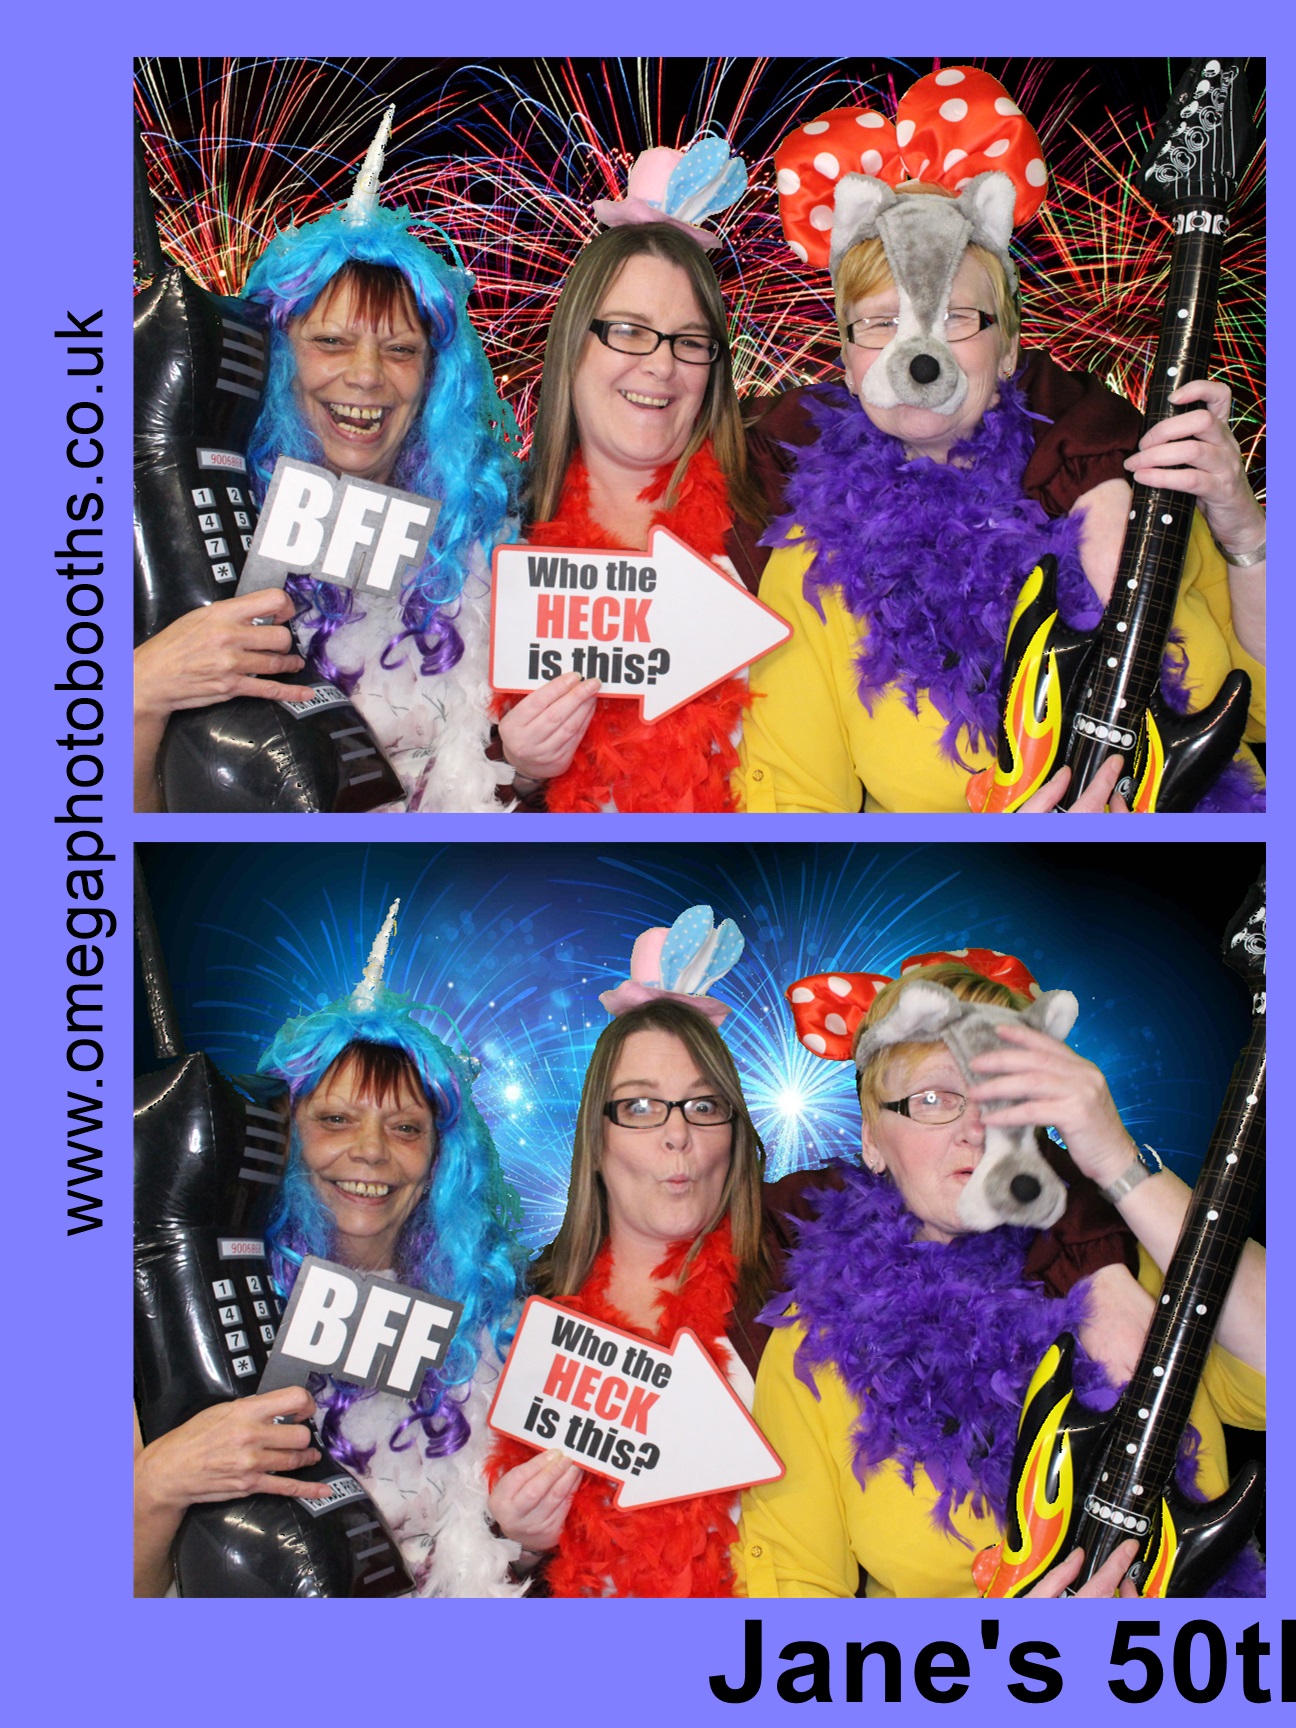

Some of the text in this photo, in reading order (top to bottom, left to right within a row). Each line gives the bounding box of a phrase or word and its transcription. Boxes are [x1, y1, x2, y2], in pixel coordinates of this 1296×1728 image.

[198, 489, 239, 503] 1 2
[205, 513, 247, 527] 4 5
[258, 466, 430, 591] BFF
[210, 537, 252, 553] 7 8
[528, 557, 656, 592] Who the
[536, 594, 652, 643] HECK
[528, 643, 670, 685] is this?
[219, 1278, 259, 1294] 1 2
[225, 1303, 266, 1320] 4 5
[281, 1265, 453, 1392] BFF
[231, 1327, 272, 1347] 7 8
[551, 1315, 672, 1388] Who the
[543, 1353, 660, 1435] HECK
[523, 1397, 660, 1476] is this?
